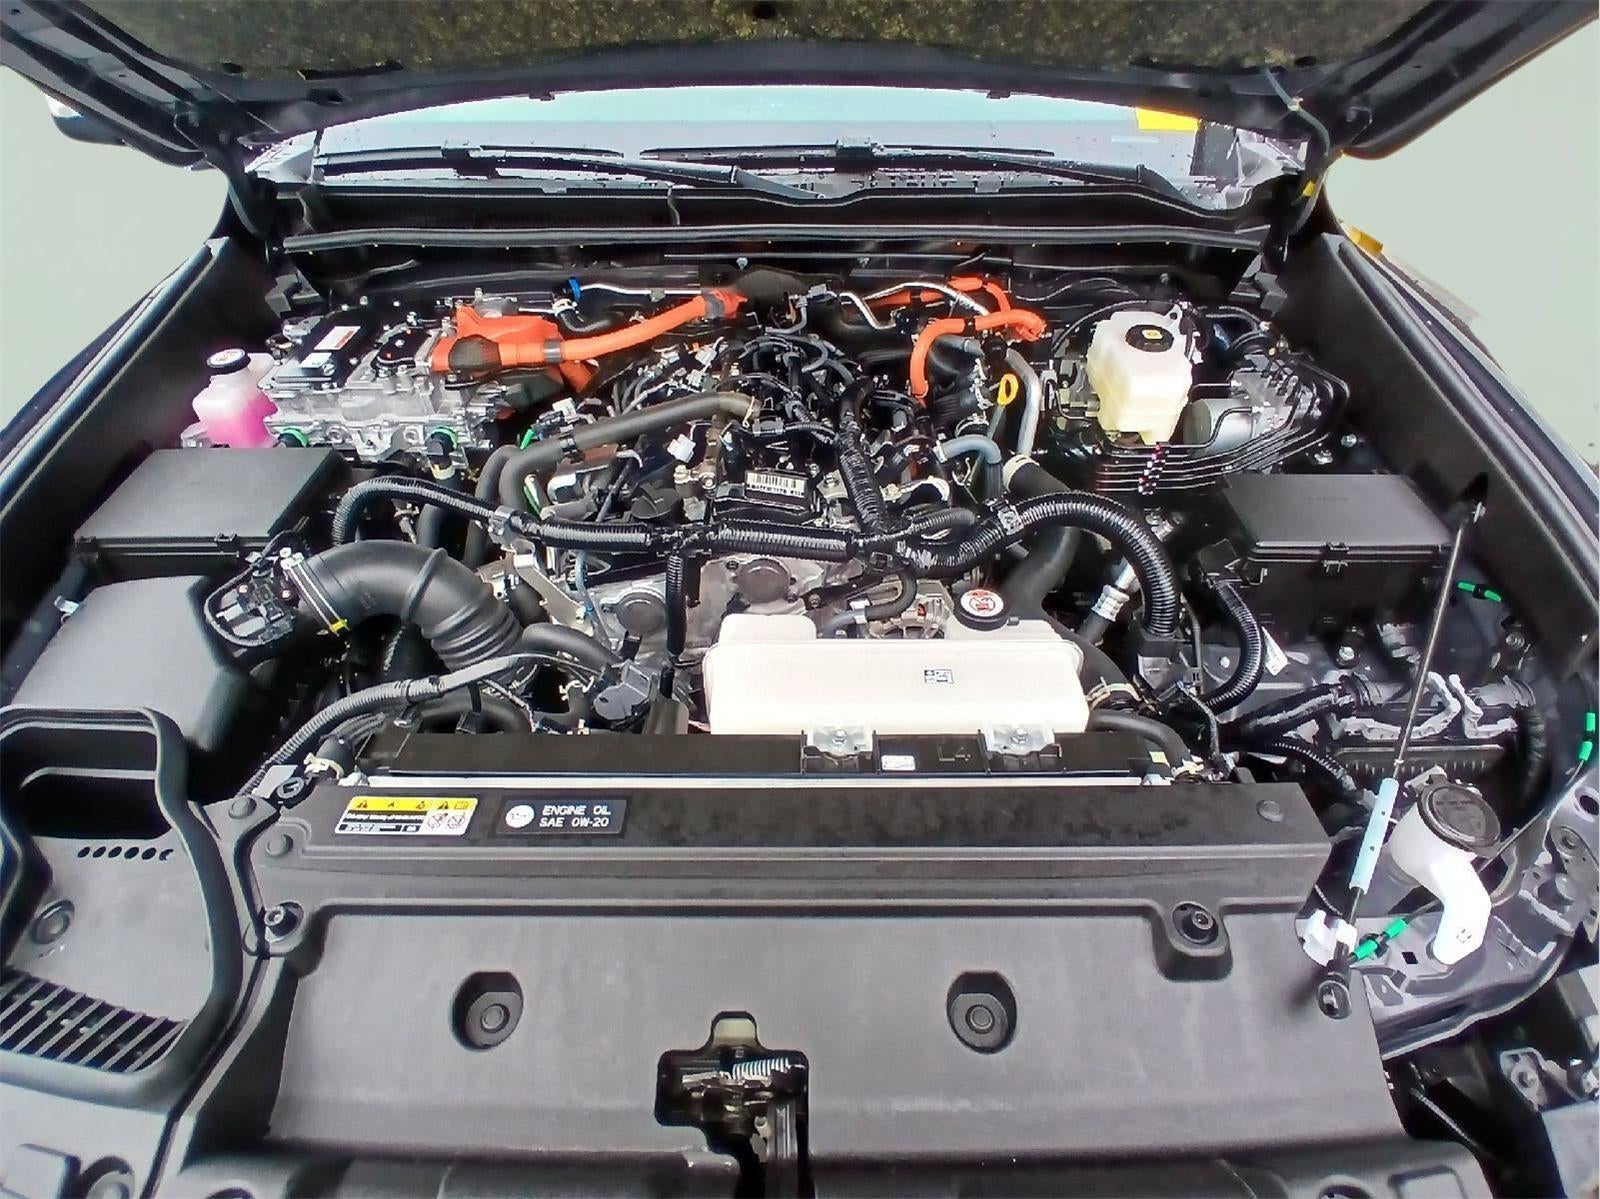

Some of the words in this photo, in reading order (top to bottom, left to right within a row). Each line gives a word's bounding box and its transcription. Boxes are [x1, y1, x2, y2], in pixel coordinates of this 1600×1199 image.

[542, 805, 587, 816] ENGINE
[593, 805, 611, 816] OIL
[539, 817, 565, 827] SAE
[571, 817, 609, 827] 0W-20
